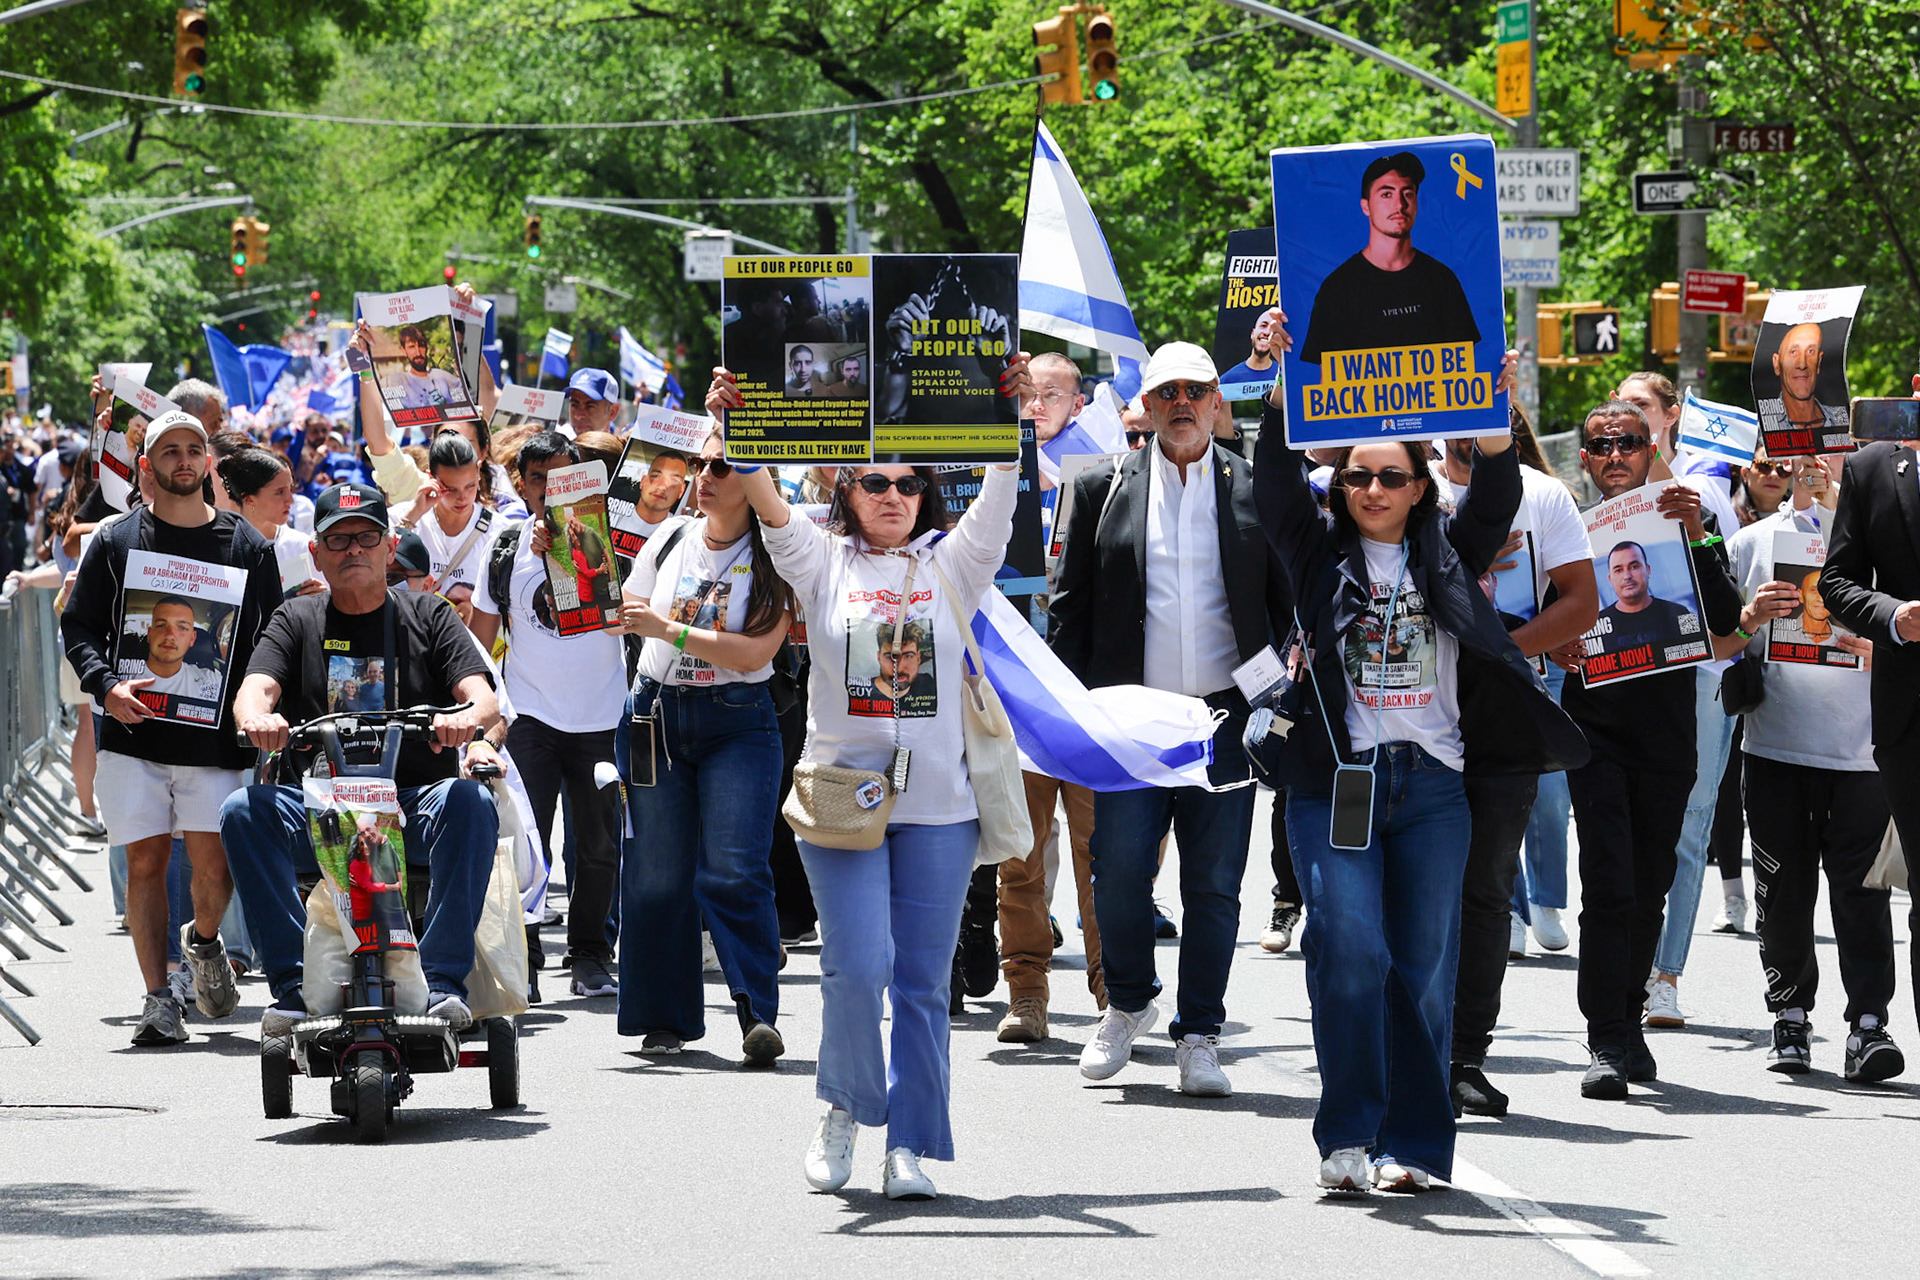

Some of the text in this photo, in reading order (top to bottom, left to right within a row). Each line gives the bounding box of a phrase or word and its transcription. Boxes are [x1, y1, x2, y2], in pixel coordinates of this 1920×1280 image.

[1738, 130, 1760, 150] 66
[1767, 130, 1785, 150] St
[1498, 160, 1572, 177] ASSENGER
[1499, 184, 1571, 202] ARS ONLY
[1648, 184, 1679, 200] ONE
[1504, 226, 1549, 239] NYPD
[738, 261, 853, 273] LET OUR PEOPLE GO
[1228, 278, 1245, 288] THE
[912, 319, 982, 335] LET OUR
[912, 340, 1005, 356] PEOPLE GO
[1330, 346, 1467, 381] I WANT TO BE
[912, 369, 962, 378] STAND UP,
[382, 386, 406, 400] BRING
[741, 391, 783, 399] sychological
[965, 388, 995, 396] VOICE
[1242, 384, 1273, 394] Eitan Mo
[1310, 377, 1485, 417] BACK HOME TOO
[757, 401, 770, 409] Guy
[825, 401, 849, 409] Evyatar
[851, 400, 869, 408] David
[1758, 399, 1784, 416] BRING
[165, 413, 188, 424] alo
[392, 410, 416, 422] HOME
[415, 405, 440, 419] NOW!
[747, 410, 773, 418] brought
[833, 420, 862, 428] February
[1762, 413, 1779, 431] HIM
[1765, 429, 1814, 449] HOME NOW!
[730, 444, 866, 454] YOUR VOICE IS ALL THEY HAVE
[957, 483, 983, 496] BRIN
[607, 497, 635, 517] BRING
[1587, 501, 1654, 533] MUHAMMAD ALATRASH
[1612, 519, 1627, 533] (40)
[1806, 546, 1817, 555] YAIR
[143, 565, 230, 589] BAR ABRAHAM KUPERSHTEIN
[552, 577, 577, 597] BRING
[555, 595, 581, 611] THEM
[558, 610, 582, 629] HOME
[581, 605, 602, 624] NOW!
[1773, 618, 1797, 631] BRING
[1772, 630, 1788, 643] HIM
[328, 641, 346, 649] 590
[1772, 643, 1794, 657] HOME
[1795, 645, 1819, 659] NOW!
[118, 659, 146, 674] BRING
[680, 656, 692, 668] AND
[1586, 644, 1653, 676] HOME NOW!
[1363, 664, 1389, 673] JONATHN
[675, 669, 715, 682] HOME NOW!
[848, 687, 873, 697] GUY
[1367, 695, 1378, 707] ME
[1404, 694, 1416, 706] MY
[367, 793, 396, 803] AND GAD
